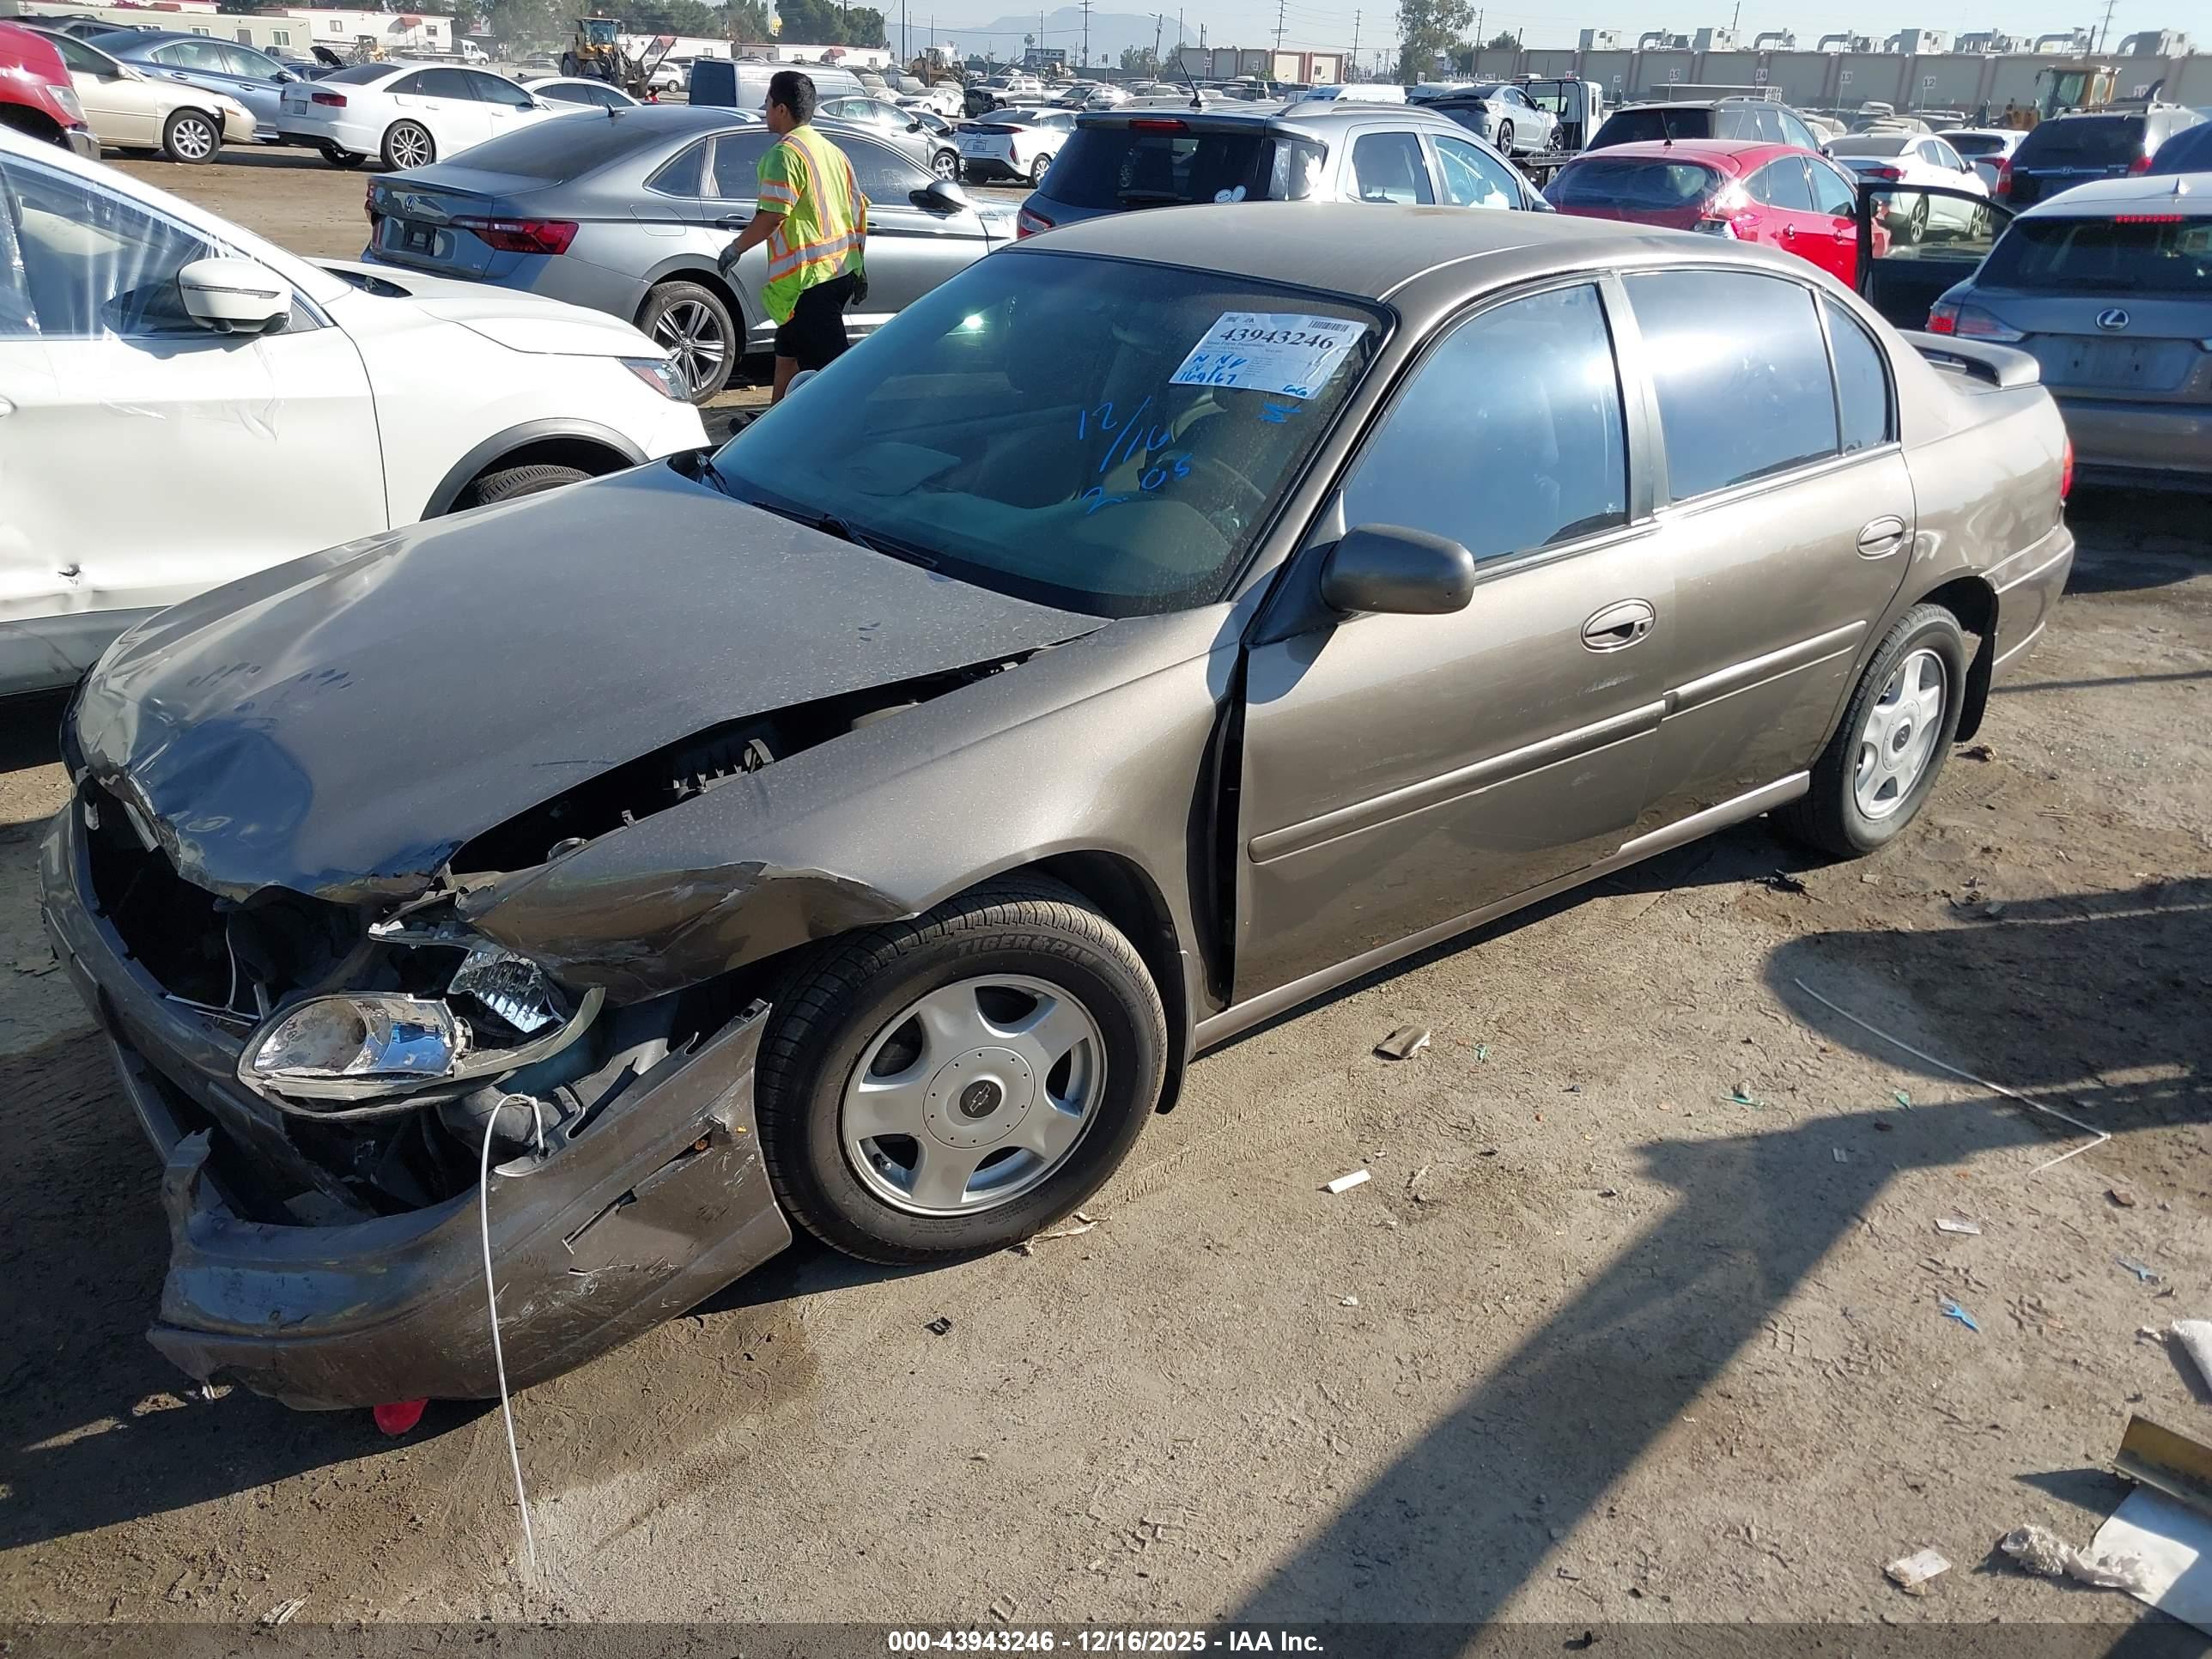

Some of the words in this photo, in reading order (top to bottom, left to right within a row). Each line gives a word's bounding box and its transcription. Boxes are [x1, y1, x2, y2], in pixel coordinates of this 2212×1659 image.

[1669, 70, 1680, 79] 15
[1842, 73, 1851, 82] 13
[1923, 78, 1935, 87] 12
[1219, 327, 1336, 349] 43943246
[957, 935, 1032, 957] TIGER
[1049, 941, 1097, 966] PAW
